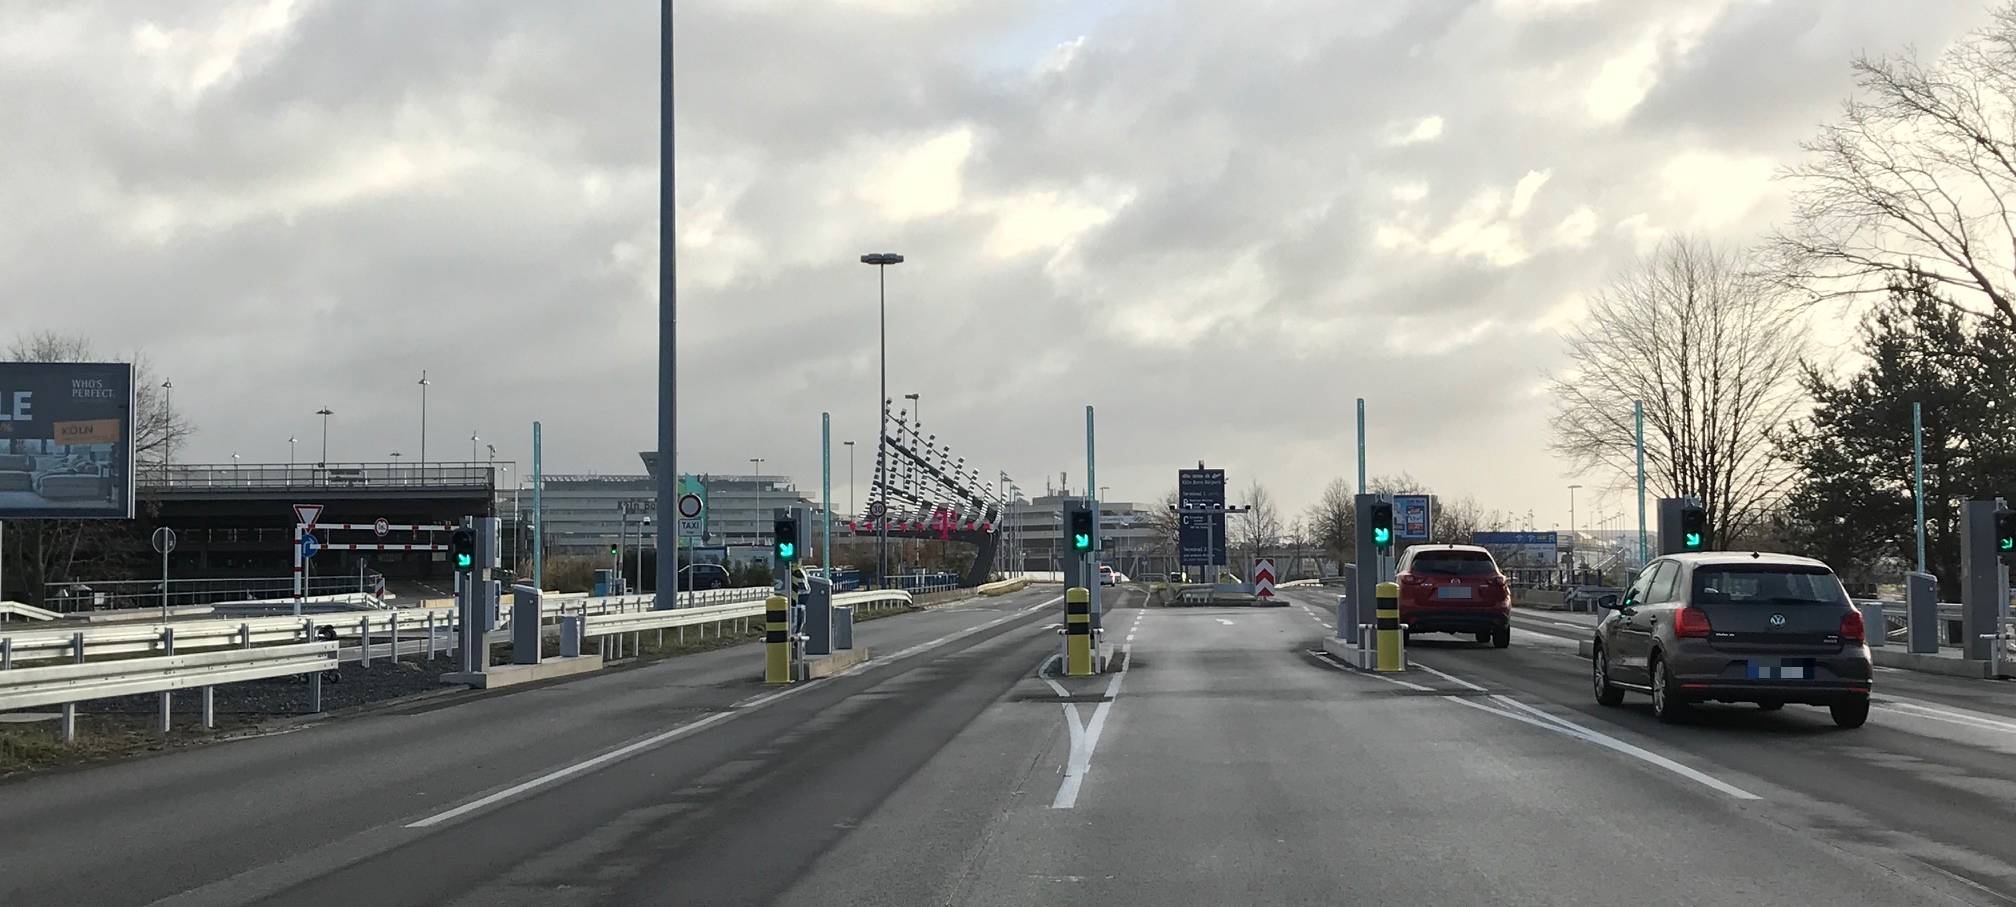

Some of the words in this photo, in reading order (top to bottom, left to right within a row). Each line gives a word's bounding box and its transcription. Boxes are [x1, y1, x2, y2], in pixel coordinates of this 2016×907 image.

[72, 379, 103, 388] WHO'S
[72, 389, 113, 398] PERFECT
[681, 521, 699, 529] TAXI
[1183, 516, 1190, 525] C
